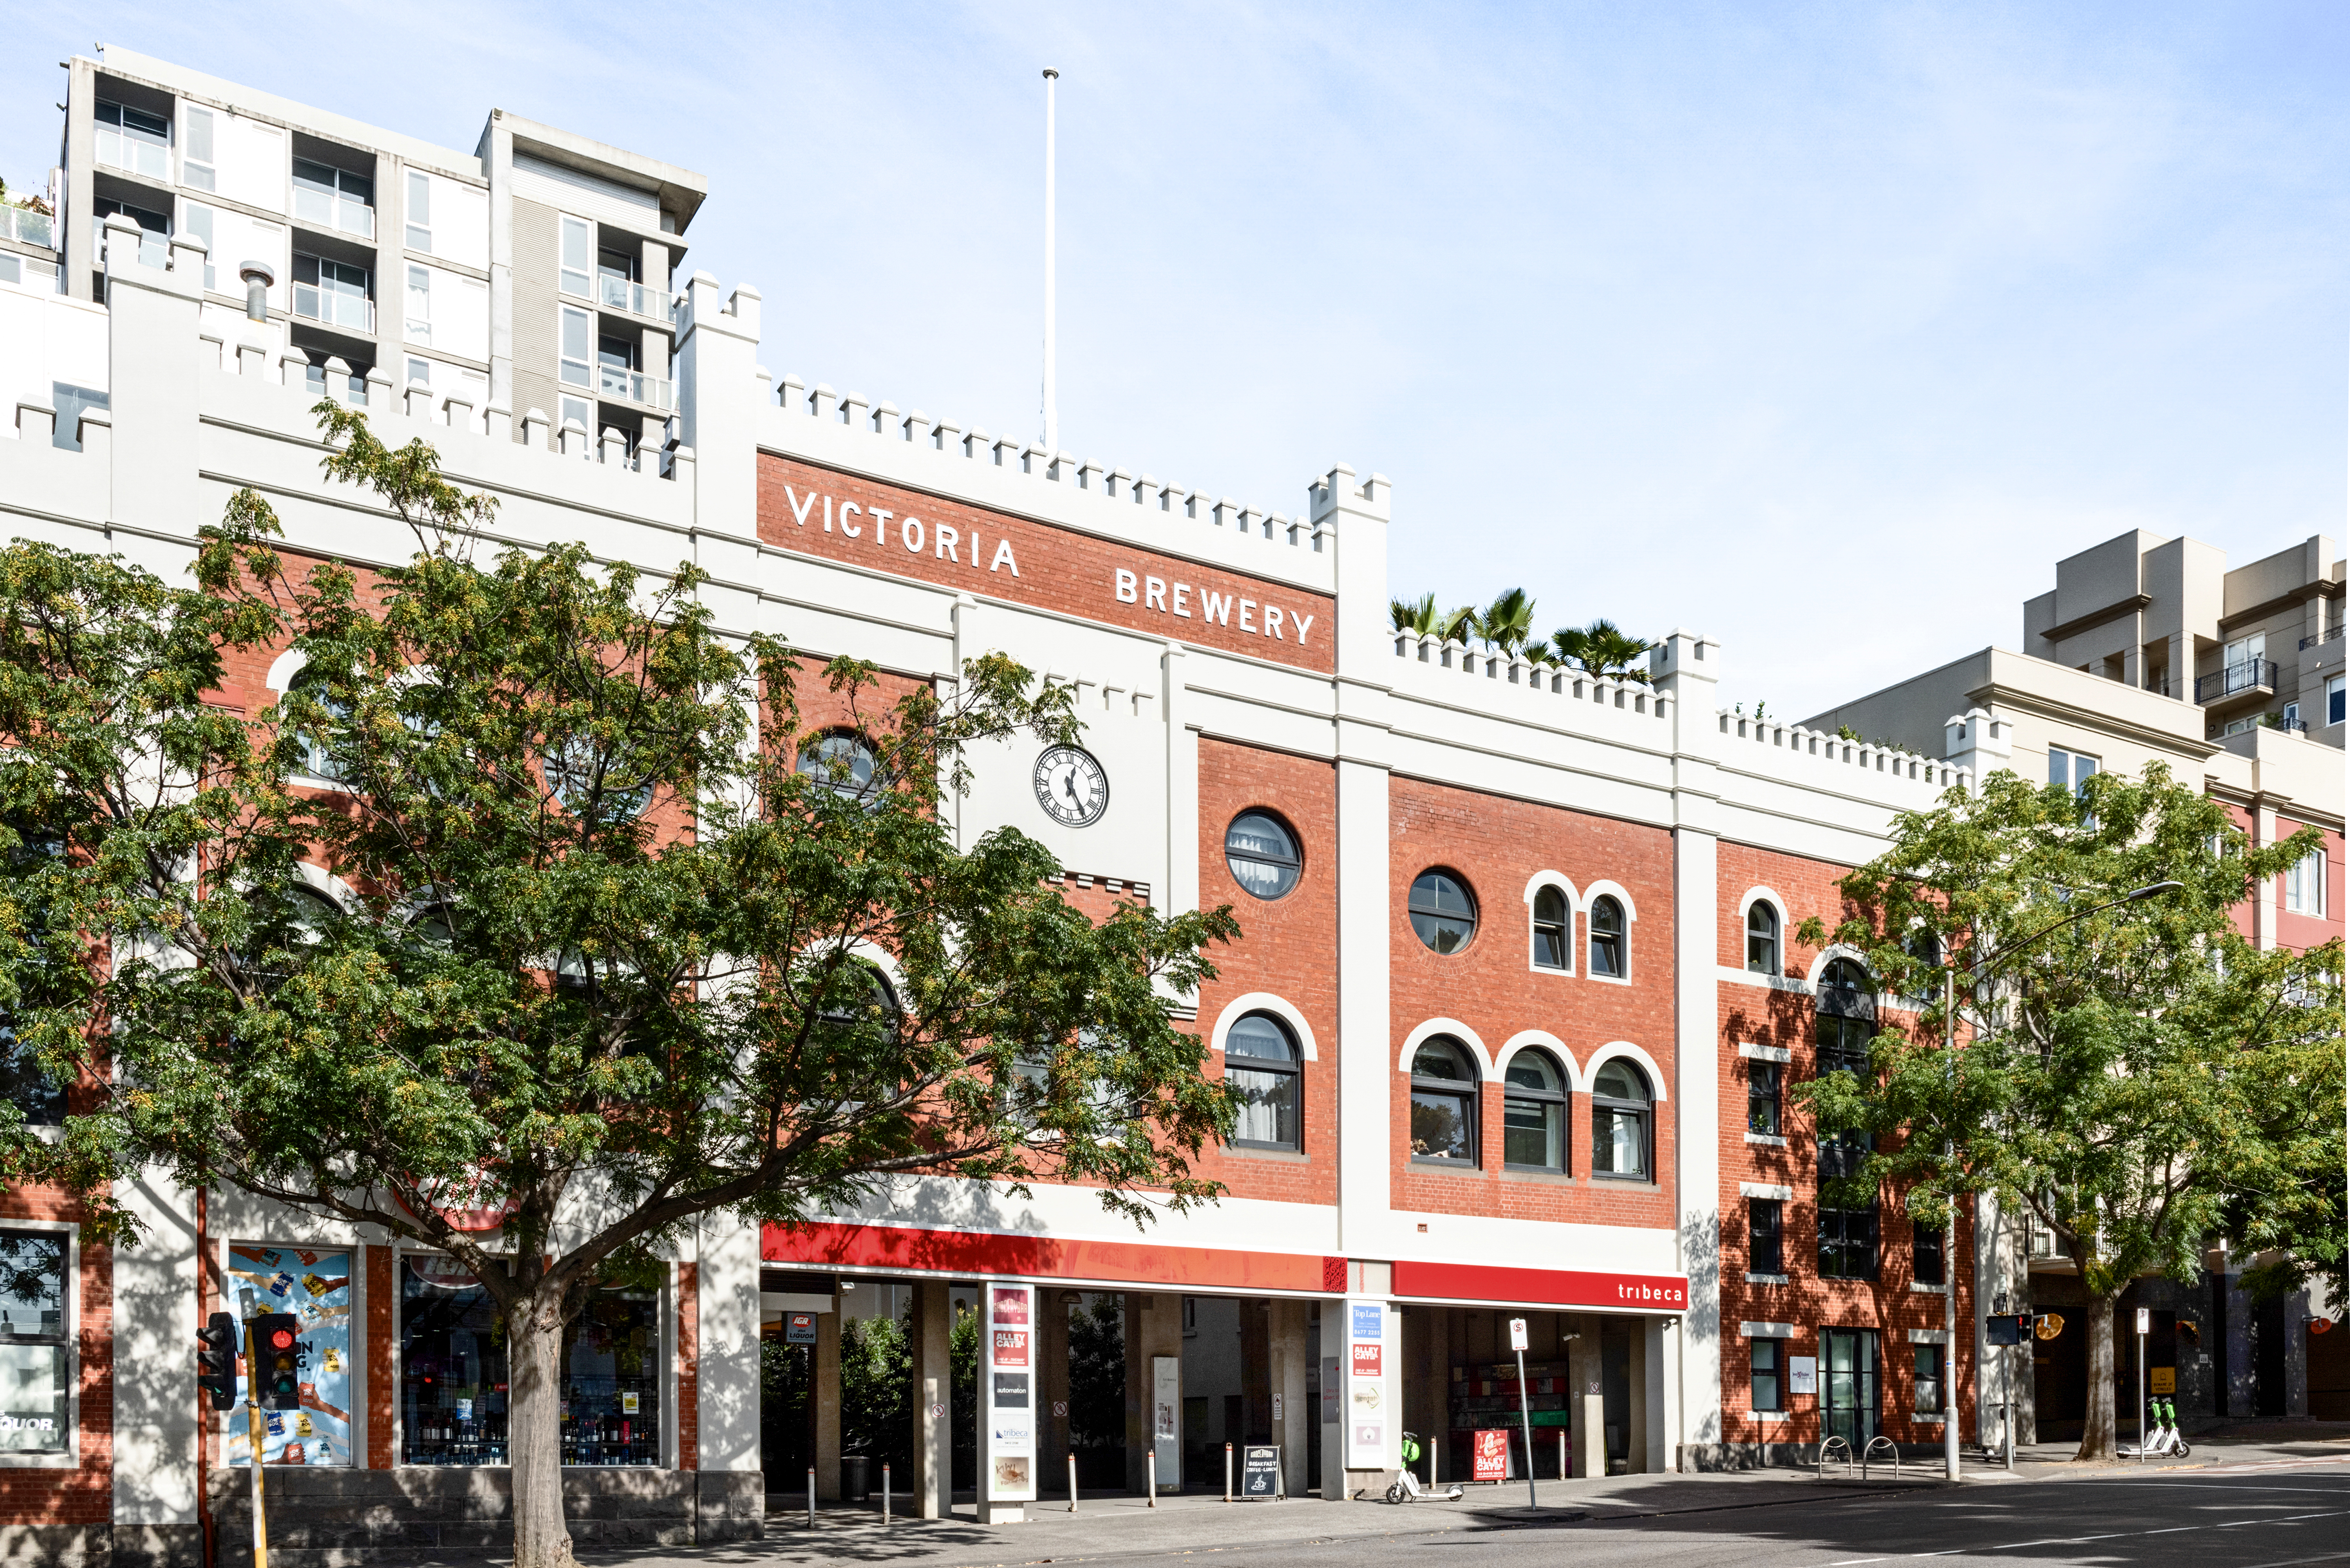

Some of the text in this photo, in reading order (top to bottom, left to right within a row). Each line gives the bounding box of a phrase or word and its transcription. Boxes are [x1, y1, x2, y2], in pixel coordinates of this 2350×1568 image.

[784, 486, 1314, 645] VICTORIA BREWERY
[1618, 1284, 1682, 1301] tribeca
[1354, 1310, 1365, 1319] Top
[996, 1463, 1015, 1474] KIWI
